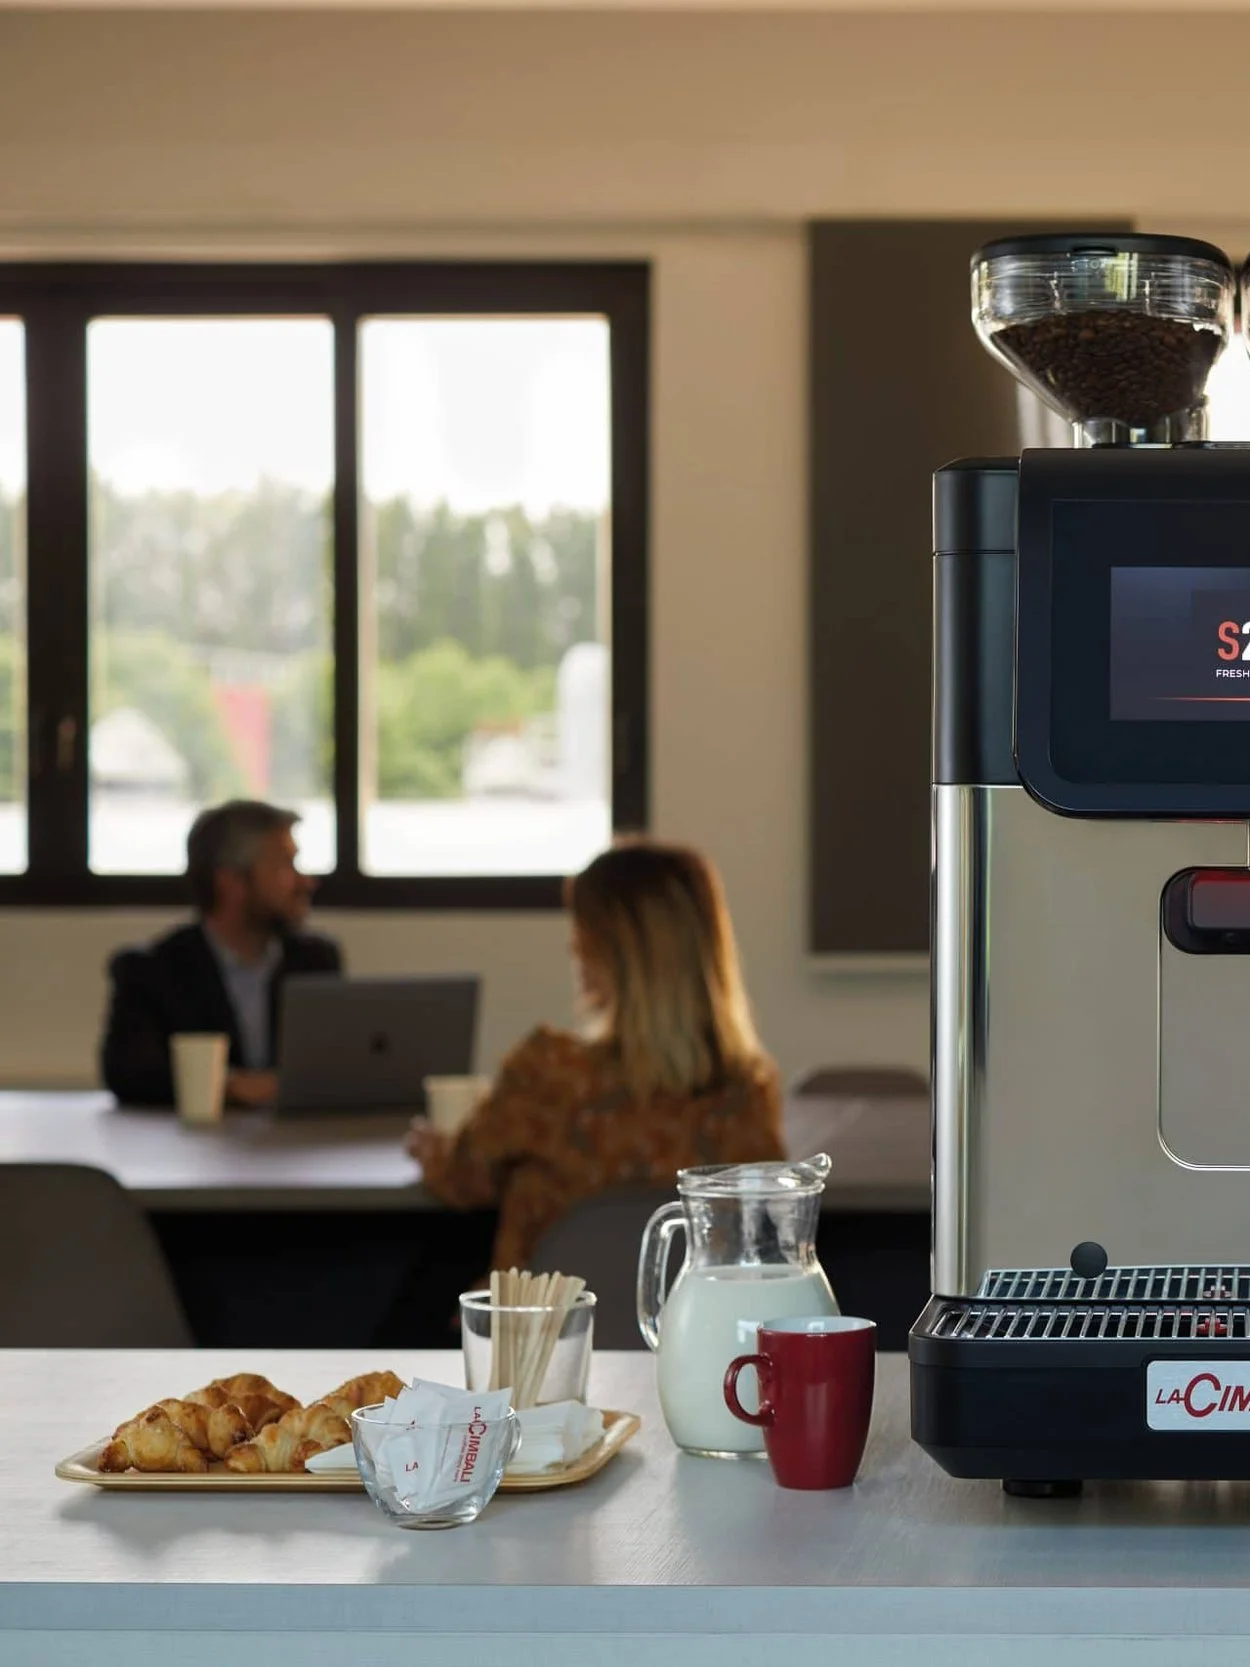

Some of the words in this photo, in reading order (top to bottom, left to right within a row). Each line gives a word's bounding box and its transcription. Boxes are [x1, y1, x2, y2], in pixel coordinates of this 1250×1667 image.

[1216, 669, 1250, 678] FRESH
[1155, 1388, 1181, 1404] LA
[474, 1406, 482, 1419] LA
[460, 1420, 487, 1483] CIMBALI
